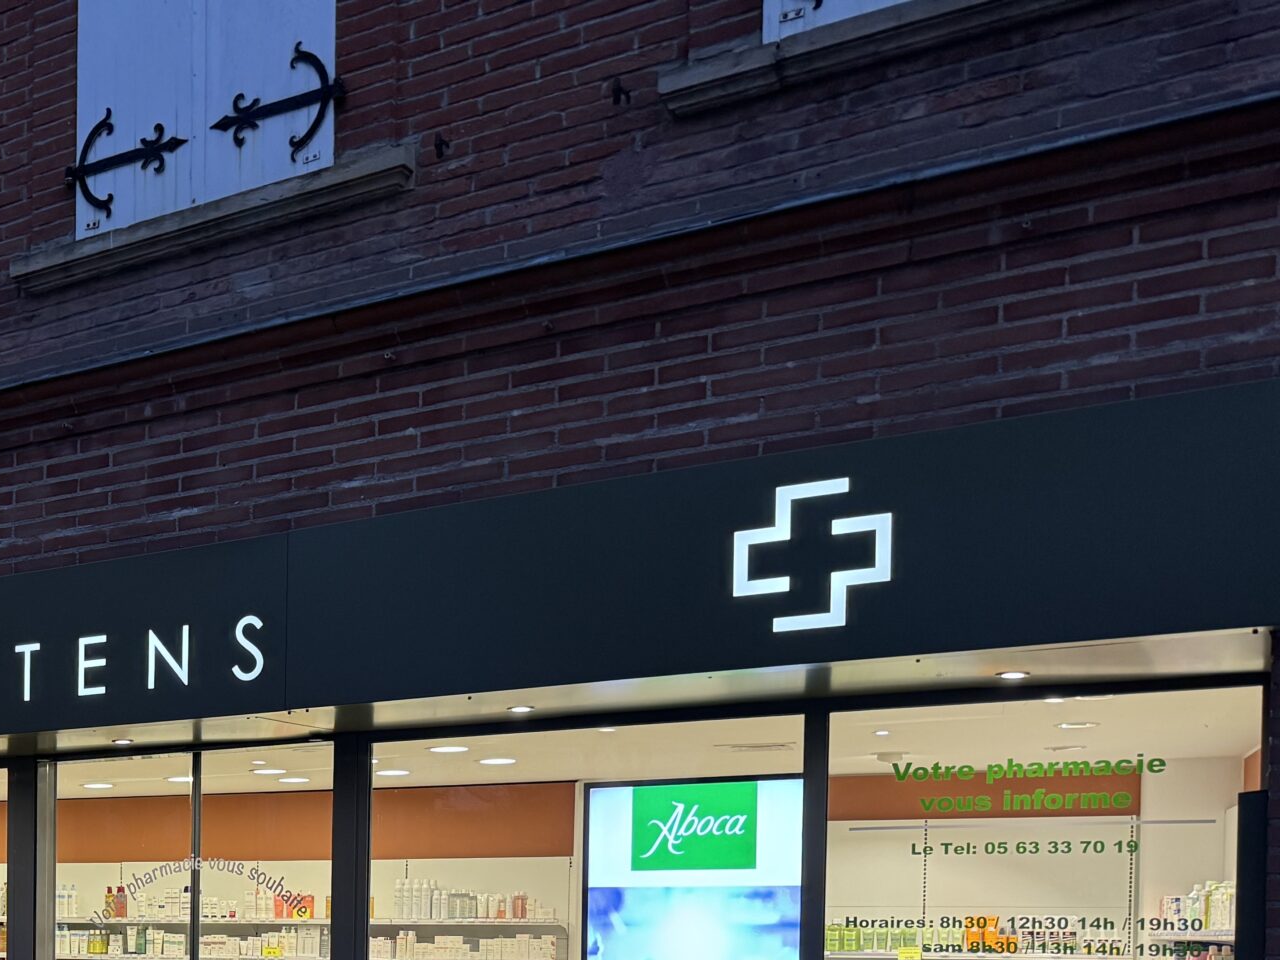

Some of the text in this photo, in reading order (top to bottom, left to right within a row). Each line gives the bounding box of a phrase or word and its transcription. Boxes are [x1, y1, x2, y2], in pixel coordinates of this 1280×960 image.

[891, 753, 1167, 784] Votre pharmacie
[920, 788, 1133, 813] vous informe
[640, 801, 747, 858] Aboca
[911, 840, 1139, 855] Le Tel: 05 63 33 70 19
[127, 854, 203, 900] pharmacie
[208, 857, 244, 876] vous
[248, 868, 308, 917] souhaite
[939, 916, 987, 929] 8h30
[1006, 916, 1068, 930] 12h30
[1077, 916, 1115, 930] 14h
[1136, 917, 1203, 932] 19h30
[922, 942, 963, 953] sam
[970, 941, 1018, 954] 8h30
[1038, 941, 1074, 955] 13h
[1135, 943, 1204, 958] 19h30
